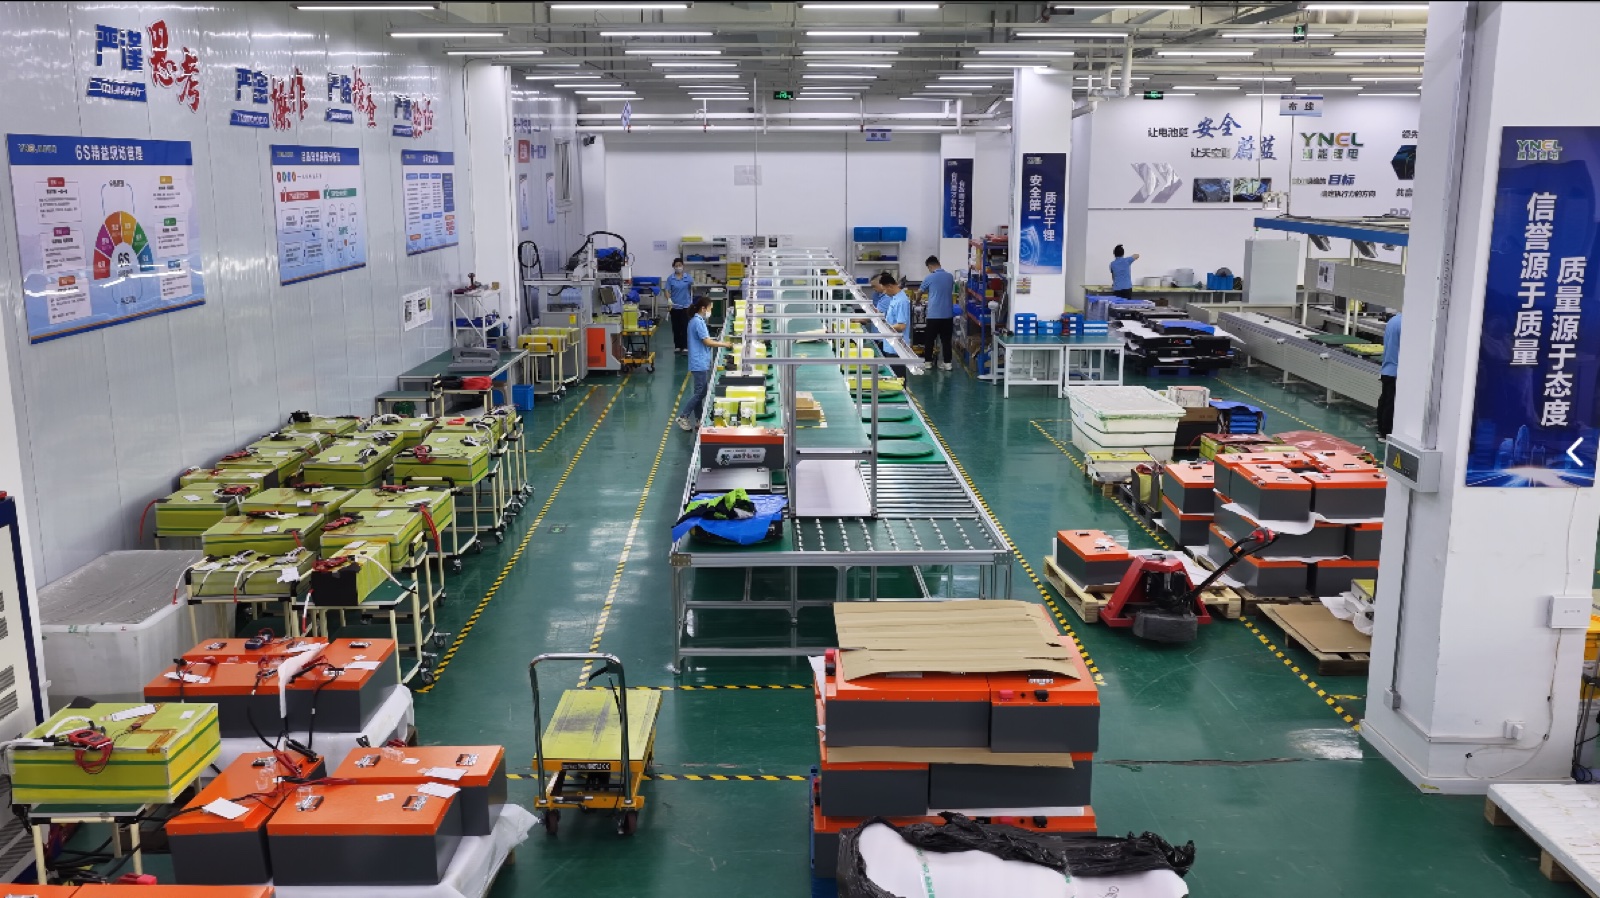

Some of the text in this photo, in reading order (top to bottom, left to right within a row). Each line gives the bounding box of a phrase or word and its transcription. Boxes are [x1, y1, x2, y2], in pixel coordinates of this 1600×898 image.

[96, 20, 200, 112] 严谨 思考
[1193, 113, 1241, 138] 安全
[1300, 132, 1364, 147] YNEL
[1516, 139, 1563, 152] YNEL
[1028, 174, 1042, 219] 安全第一
[1328, 174, 1355, 186] 目标
[1510, 191, 1557, 366] 信誉源于质量
[1540, 256, 1587, 427] 质量源于态度
